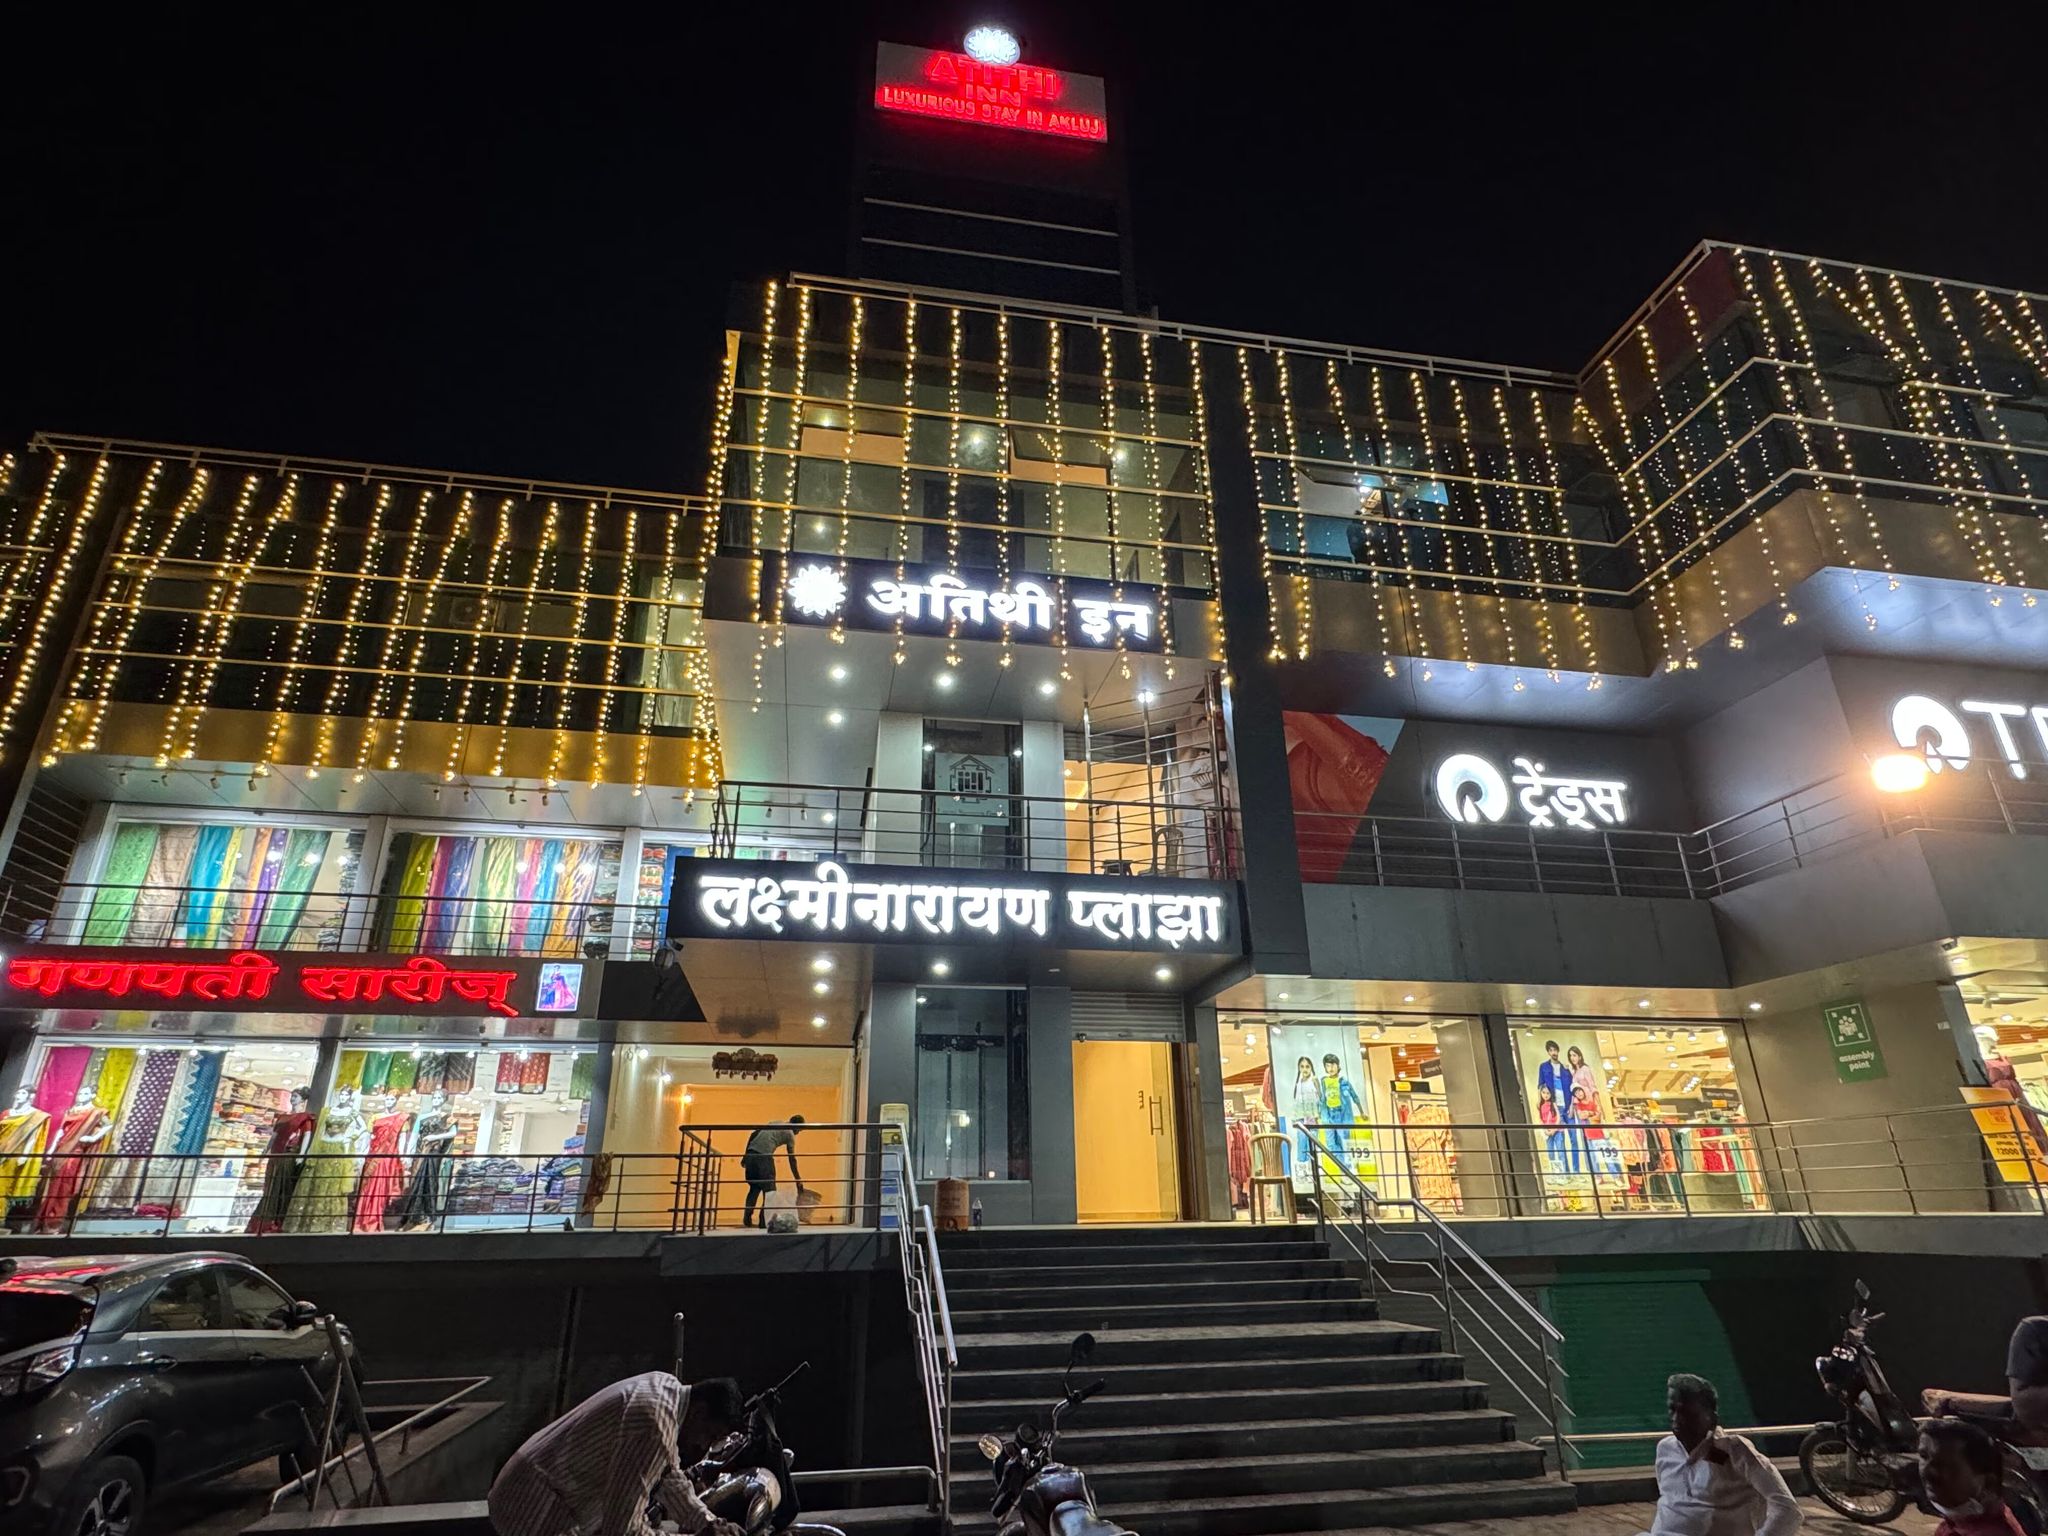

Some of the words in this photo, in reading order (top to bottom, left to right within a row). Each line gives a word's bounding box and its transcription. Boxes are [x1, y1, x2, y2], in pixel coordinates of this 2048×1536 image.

[930, 56, 1057, 100] ATITHI
[965, 83, 1022, 107] INN
[883, 86, 976, 116] LUXURIOUS
[982, 105, 1021, 122] STAY
[1026, 109, 1043, 126] IN
[1048, 113, 1100, 135] AKLUJ
[866, 573, 1055, 630] अतिथी
[1072, 598, 1154, 643] इन
[1512, 757, 1627, 830] ट्रेंड्स
[700, 861, 1051, 935] लक्ष्मीनारायण
[1067, 890, 1222, 949] प्लाझा
[9, 952, 280, 1001] गणपती
[1838, 1050, 1875, 1062] assembly
[1848, 1060, 1871, 1072] point
[1349, 1147, 1371, 1159] 199
[1599, 1147, 1619, 1158] 199
